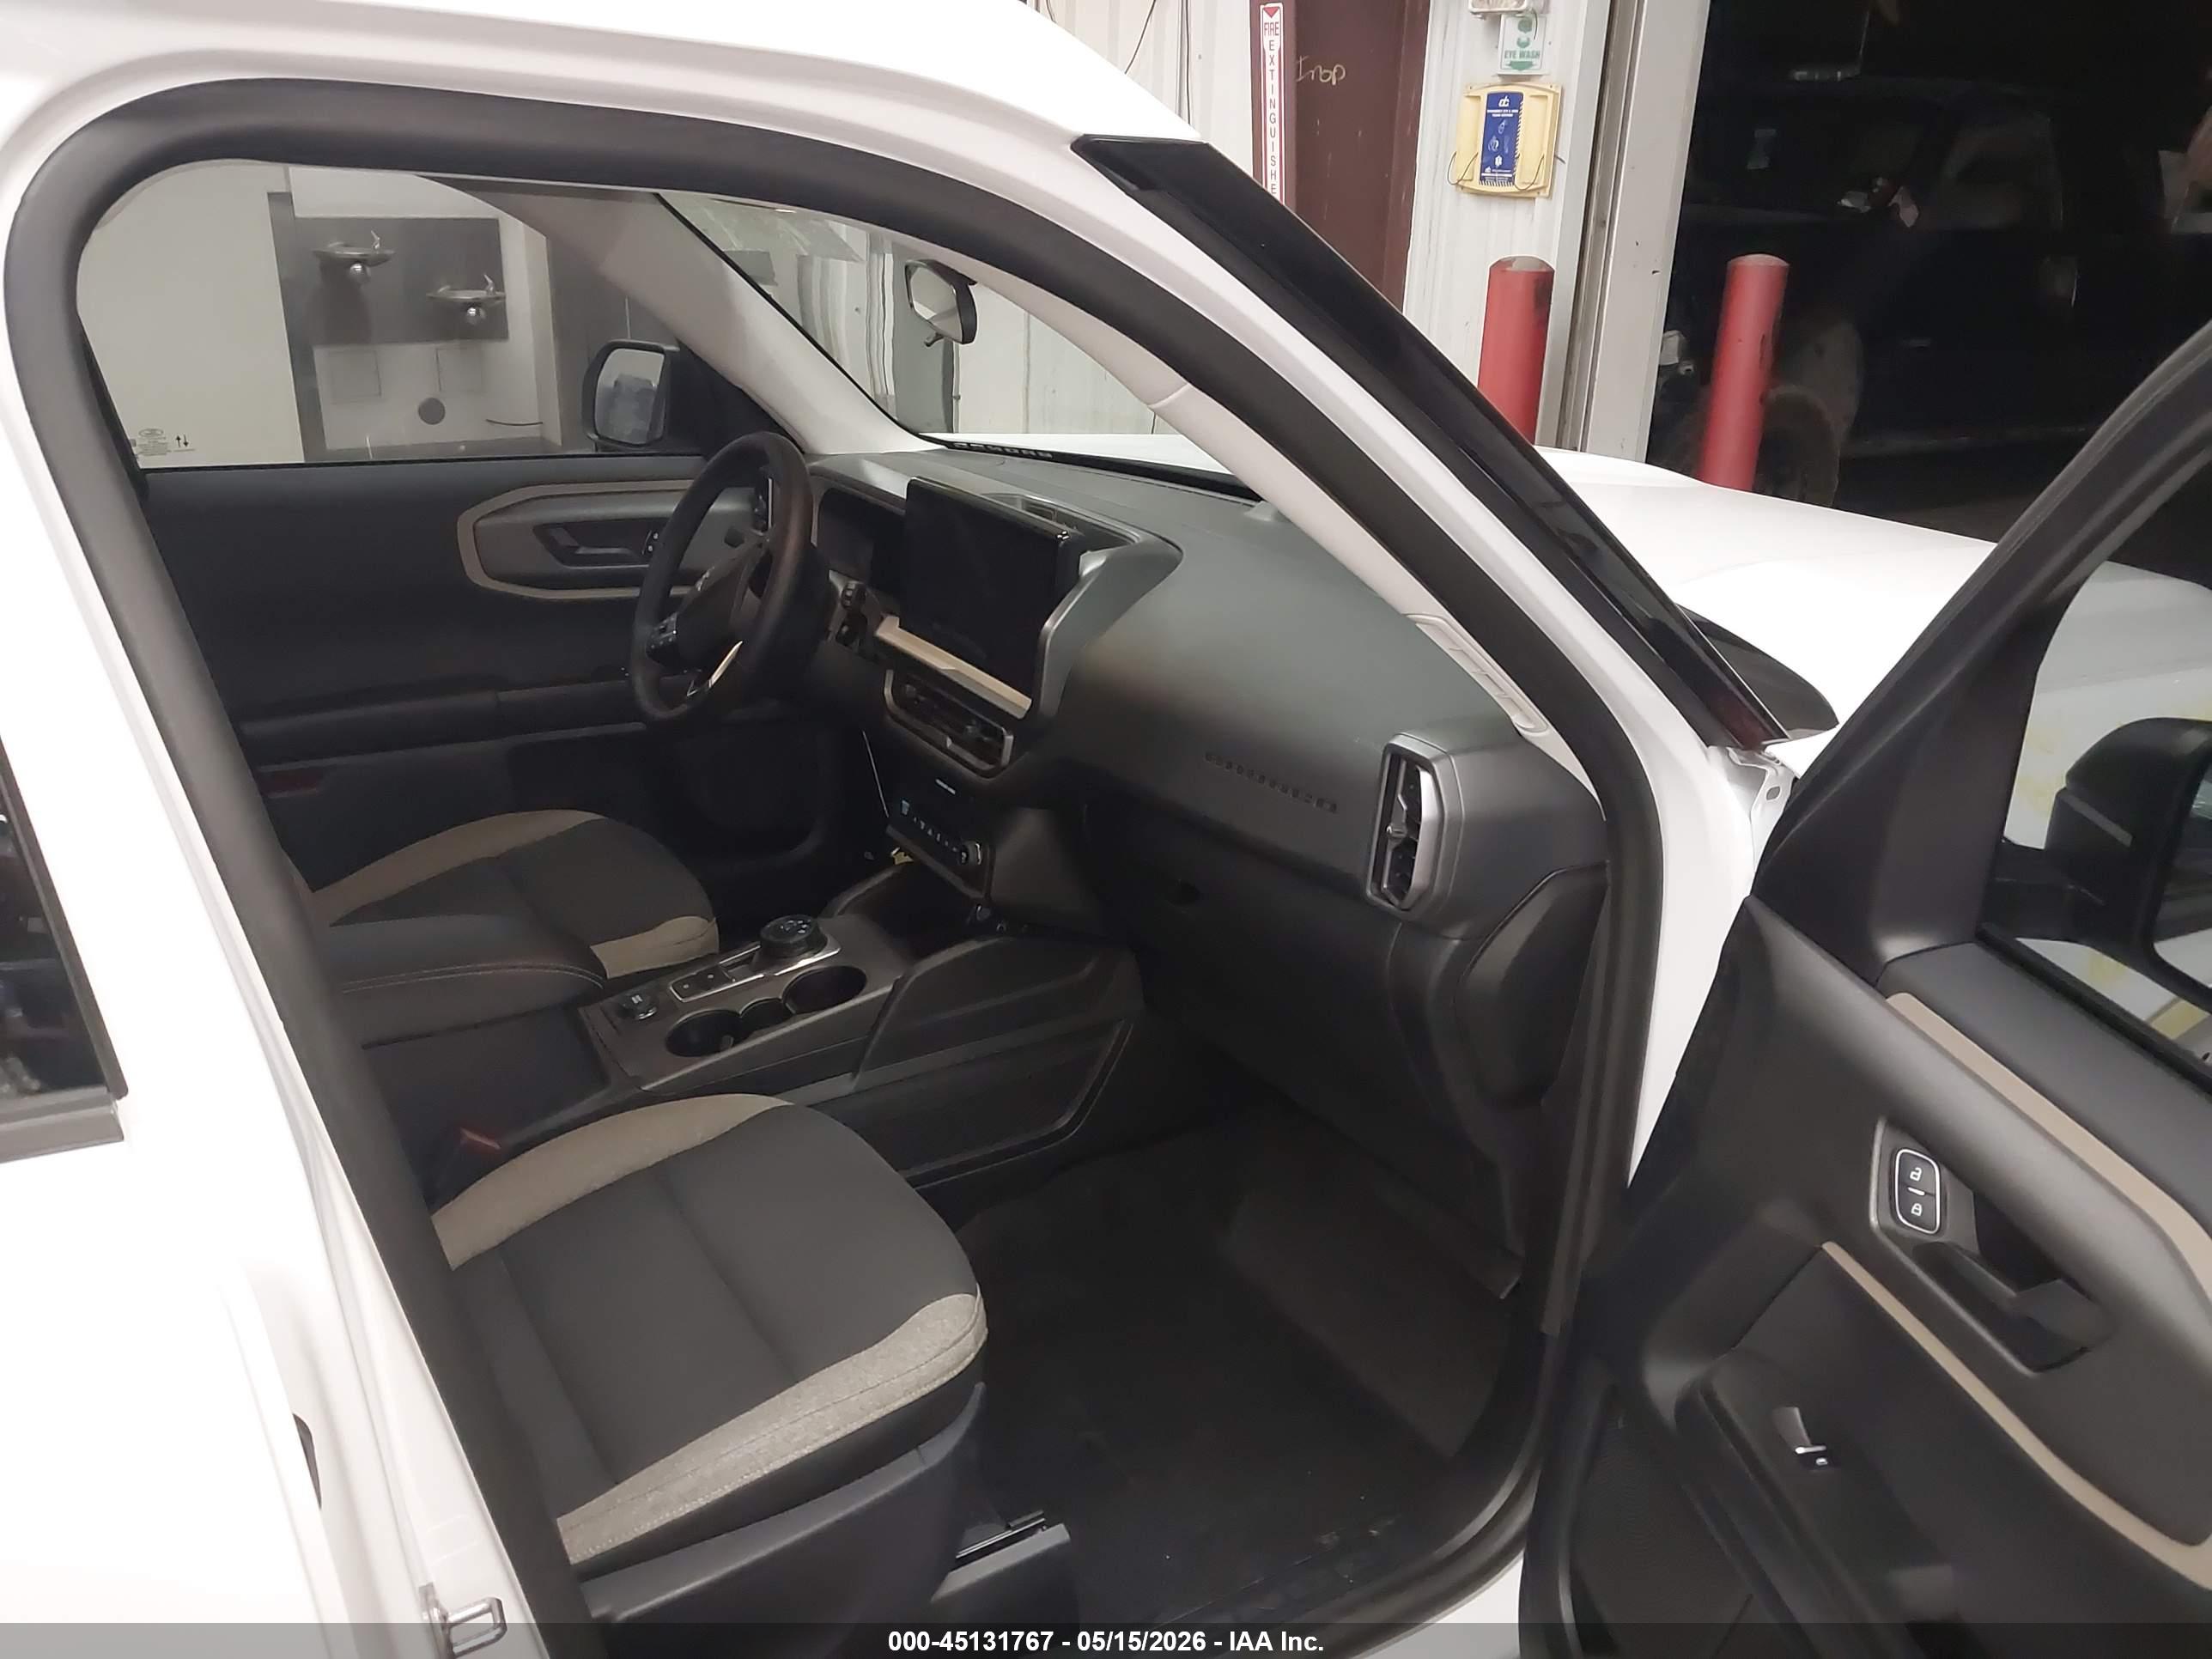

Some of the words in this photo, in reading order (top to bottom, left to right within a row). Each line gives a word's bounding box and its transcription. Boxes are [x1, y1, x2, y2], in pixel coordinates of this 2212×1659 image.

[1263, 21, 1279, 36] FIRE
[1504, 50, 1517, 59] EYE
[1518, 50, 1540, 59] WASH
[1268, 40, 1277, 195] EXTINGUISHE
